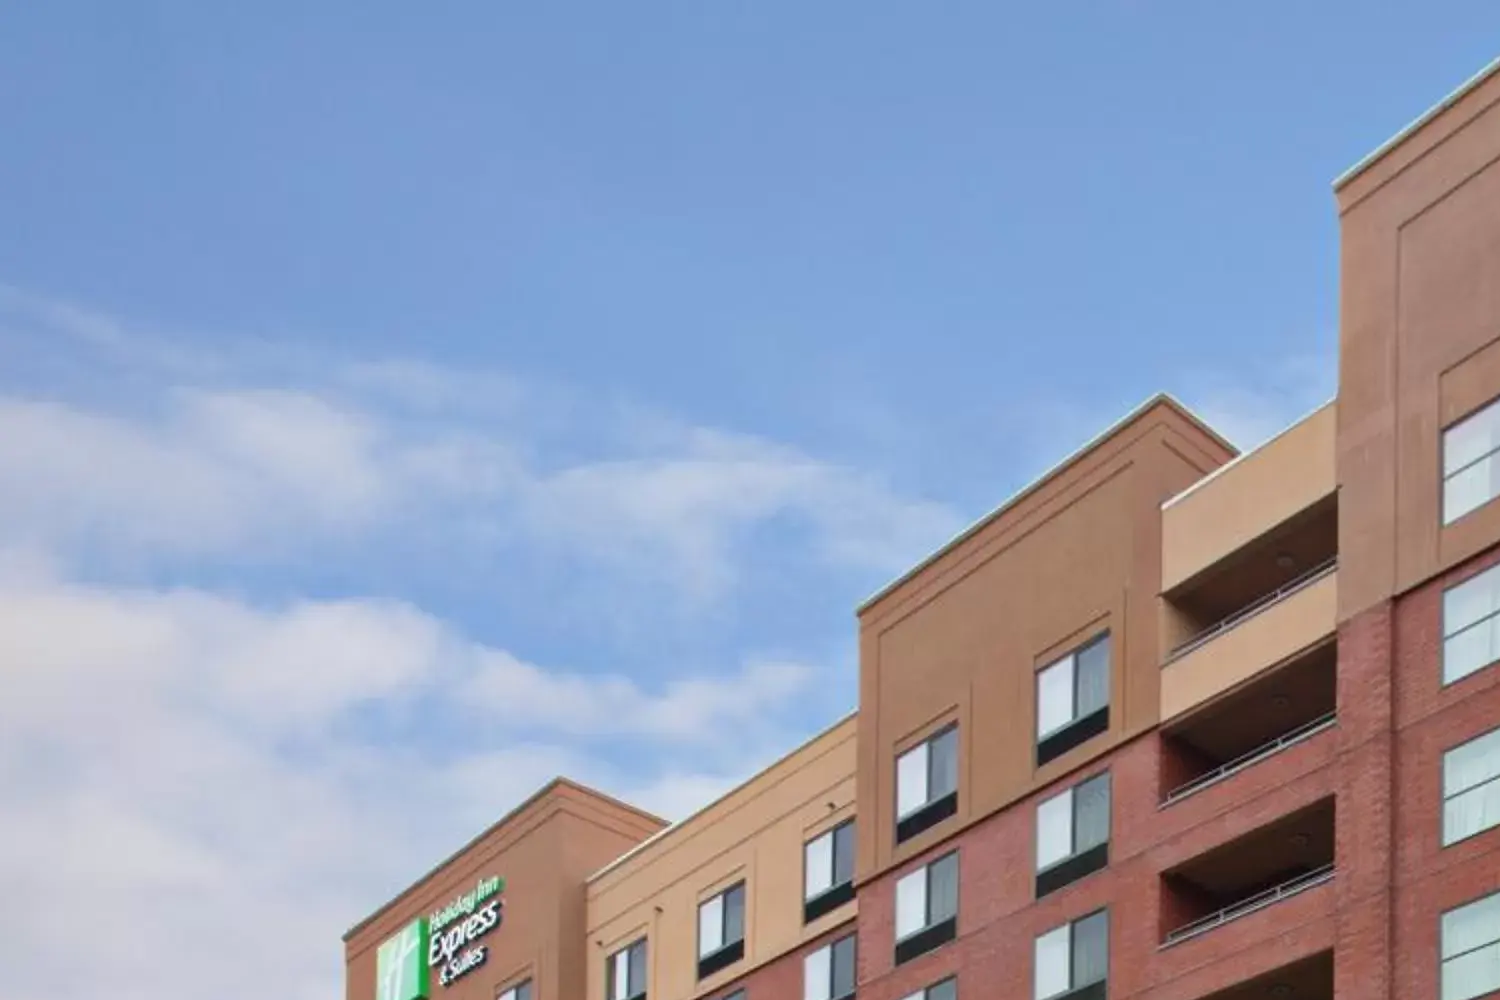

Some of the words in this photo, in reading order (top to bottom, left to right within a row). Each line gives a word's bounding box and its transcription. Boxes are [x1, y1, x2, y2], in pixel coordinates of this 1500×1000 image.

[477, 876, 503, 900] Inn
[429, 900, 501, 966] Express
[450, 945, 486, 980] Suites
